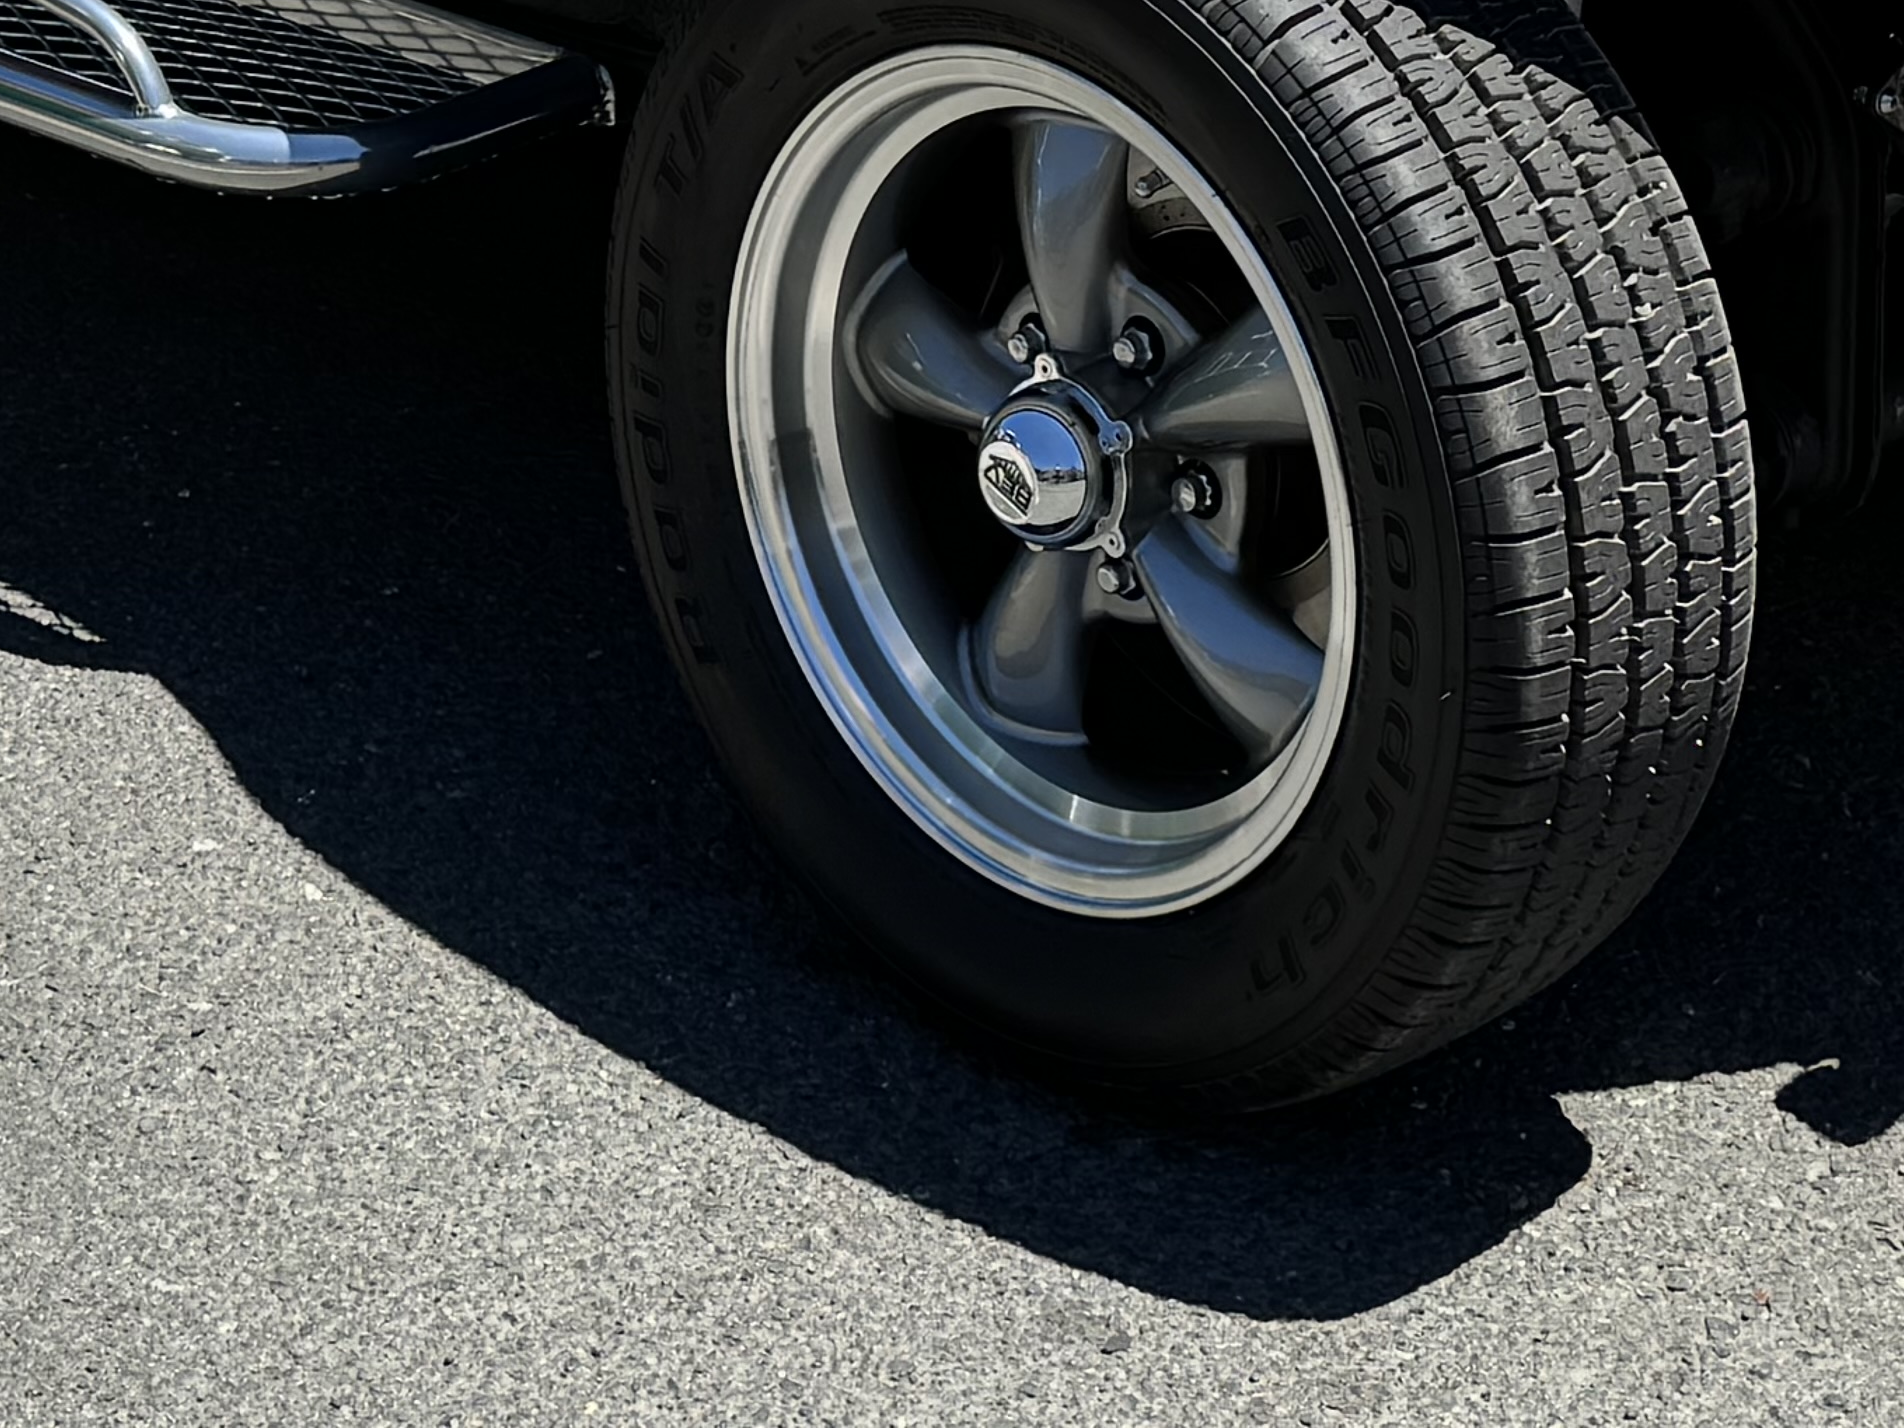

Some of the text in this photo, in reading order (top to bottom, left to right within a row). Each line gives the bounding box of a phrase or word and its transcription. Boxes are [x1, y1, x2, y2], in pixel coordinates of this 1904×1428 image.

[624, 48, 746, 666] Radial T/A
[1249, 216, 1419, 1002] BFGoodrich
